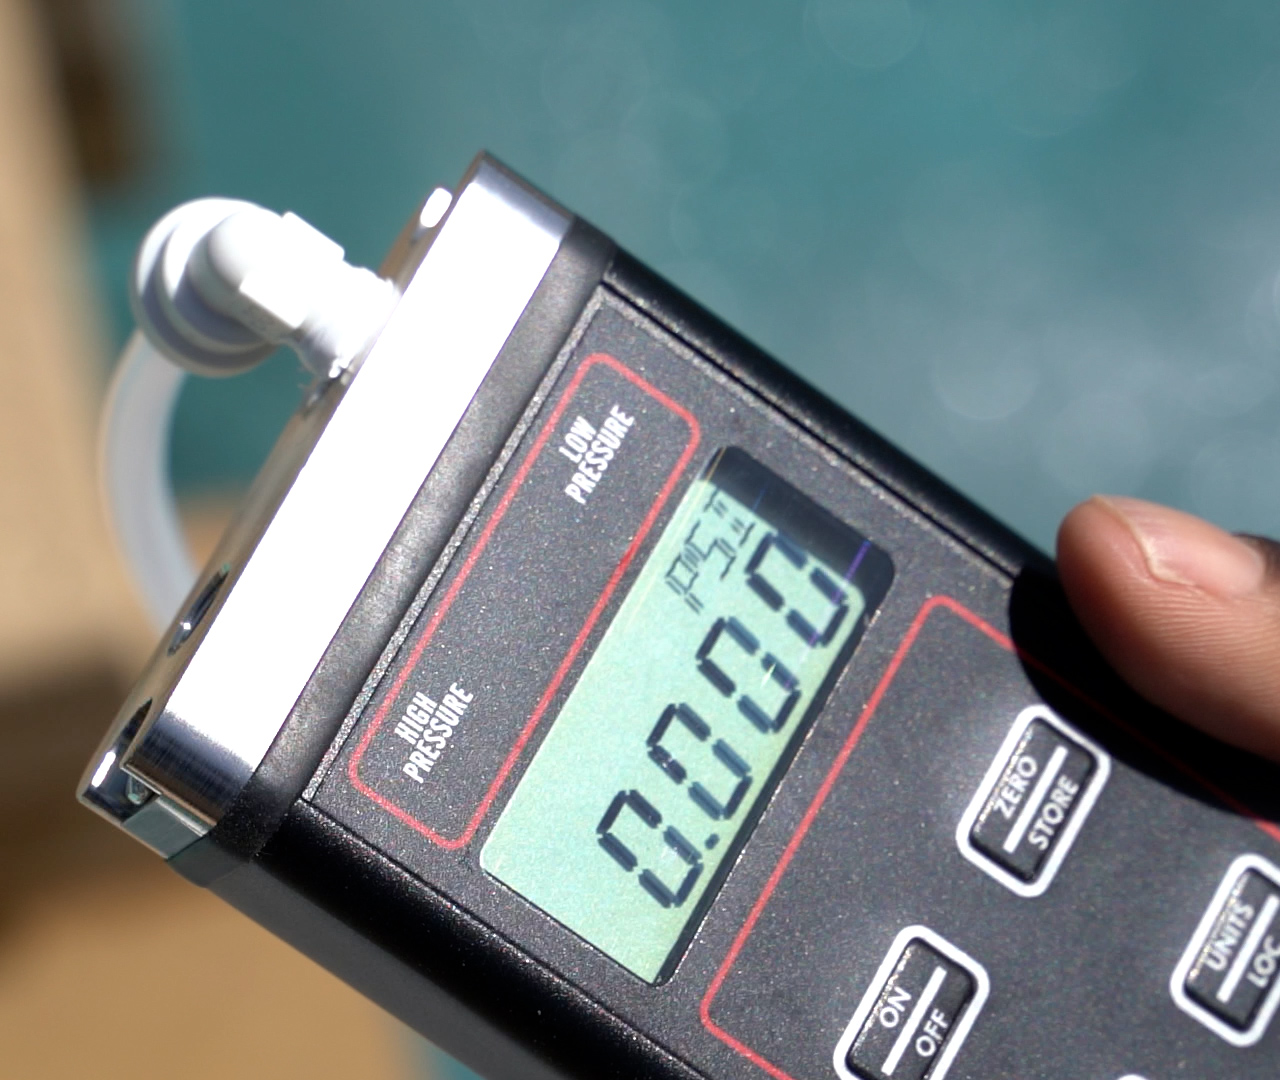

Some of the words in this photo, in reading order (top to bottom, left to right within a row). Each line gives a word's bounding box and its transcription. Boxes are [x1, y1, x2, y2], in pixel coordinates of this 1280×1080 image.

[558, 415, 598, 464] LOW
[564, 404, 635, 504] PRESSURE
[664, 488, 756, 615] PSI
[394, 690, 438, 745] HIGH
[402, 681, 474, 784] PRESSURE
[596, 531, 850, 908] 0.000
[994, 755, 1037, 820] ZERO
[1027, 774, 1079, 851] STORE
[1204, 902, 1254, 971] UNITS
[878, 986, 912, 1029] ON
[915, 1008, 949, 1058] OFF
